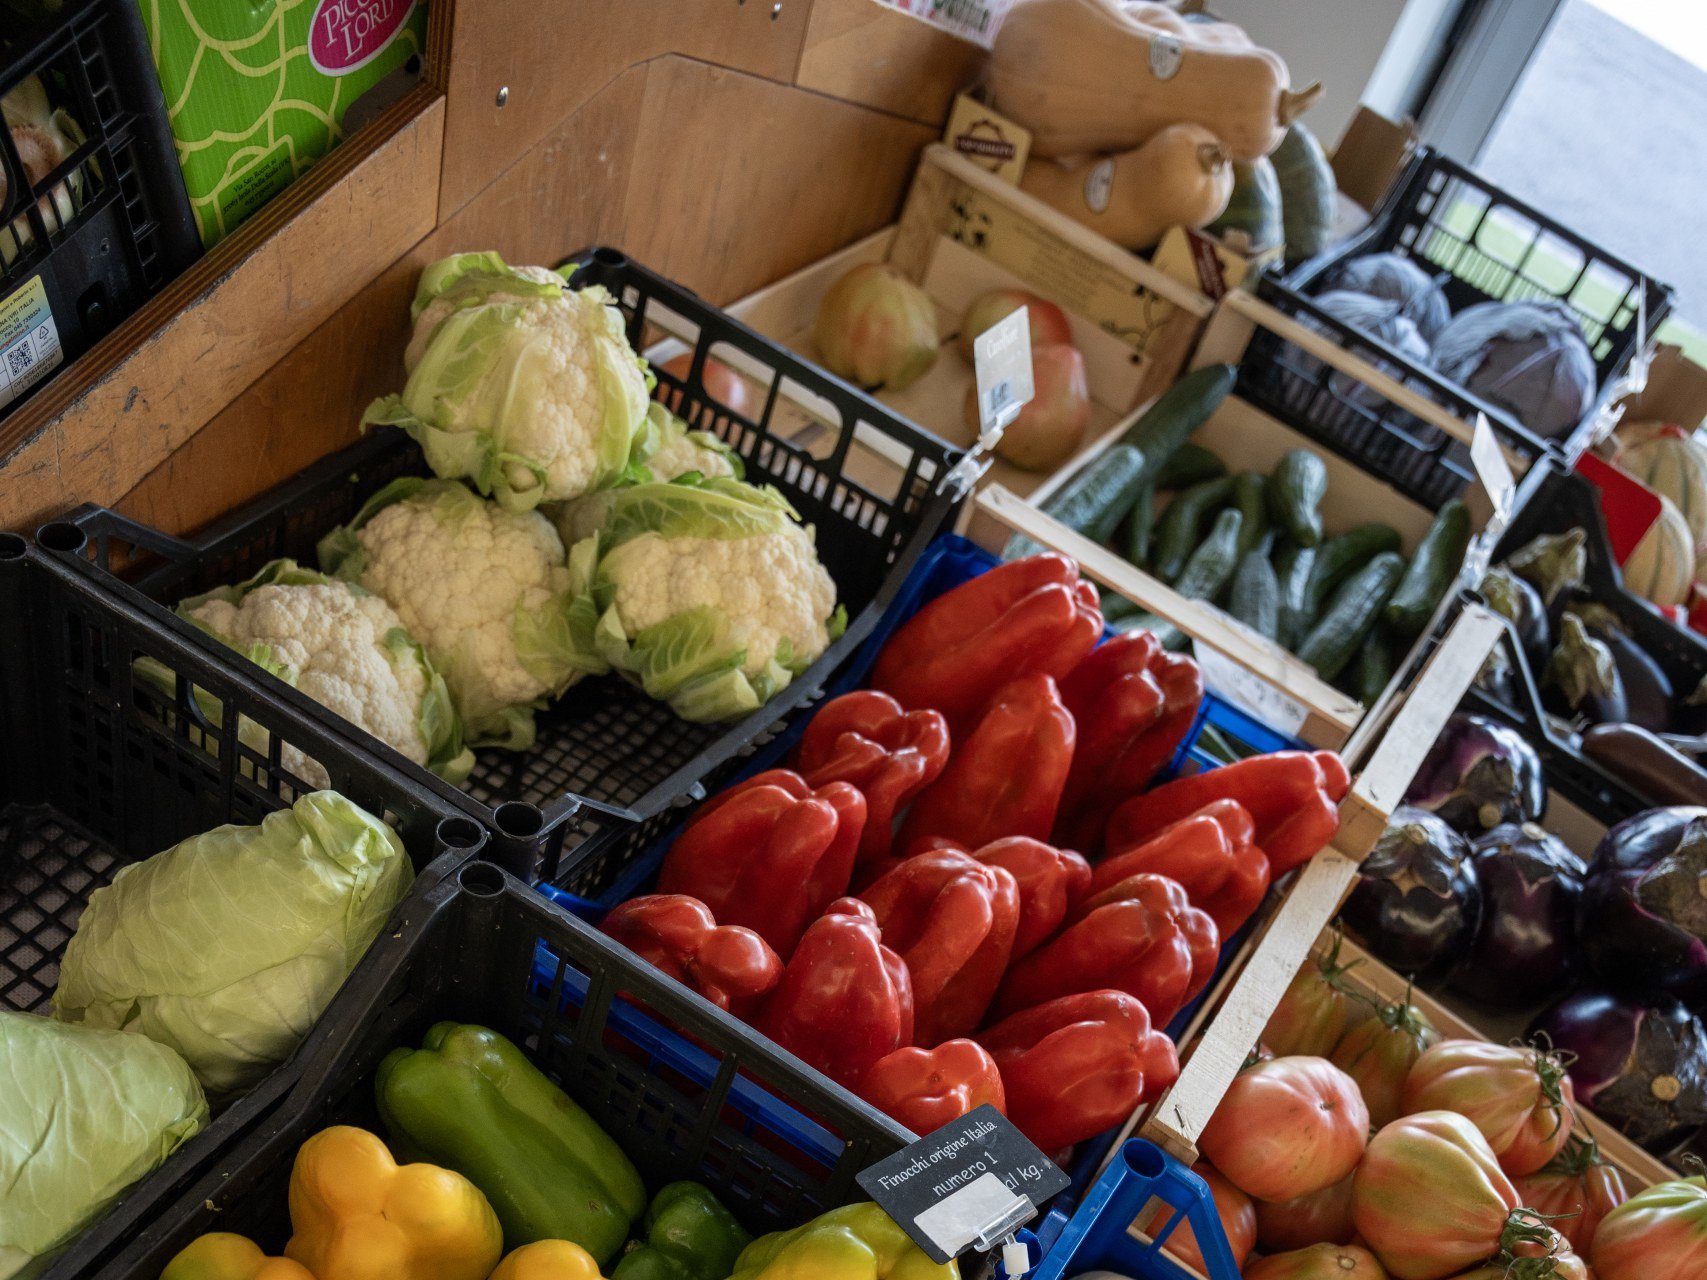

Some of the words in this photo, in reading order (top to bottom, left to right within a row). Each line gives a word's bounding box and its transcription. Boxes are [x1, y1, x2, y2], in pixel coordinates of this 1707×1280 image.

[321, 0, 370, 48] PIC
[340, 0, 394, 61] LORD
[19, 298, 34, 311] ITALIA
[877, 1157, 931, 1191] Finocchi
[930, 1137, 969, 1164] origine
[963, 1119, 998, 1142] Italia
[932, 1161, 987, 1197] numero
[984, 1151, 998, 1165] 1
[1005, 1172, 1020, 1190] al
[1019, 1162, 1045, 1184] kg.
